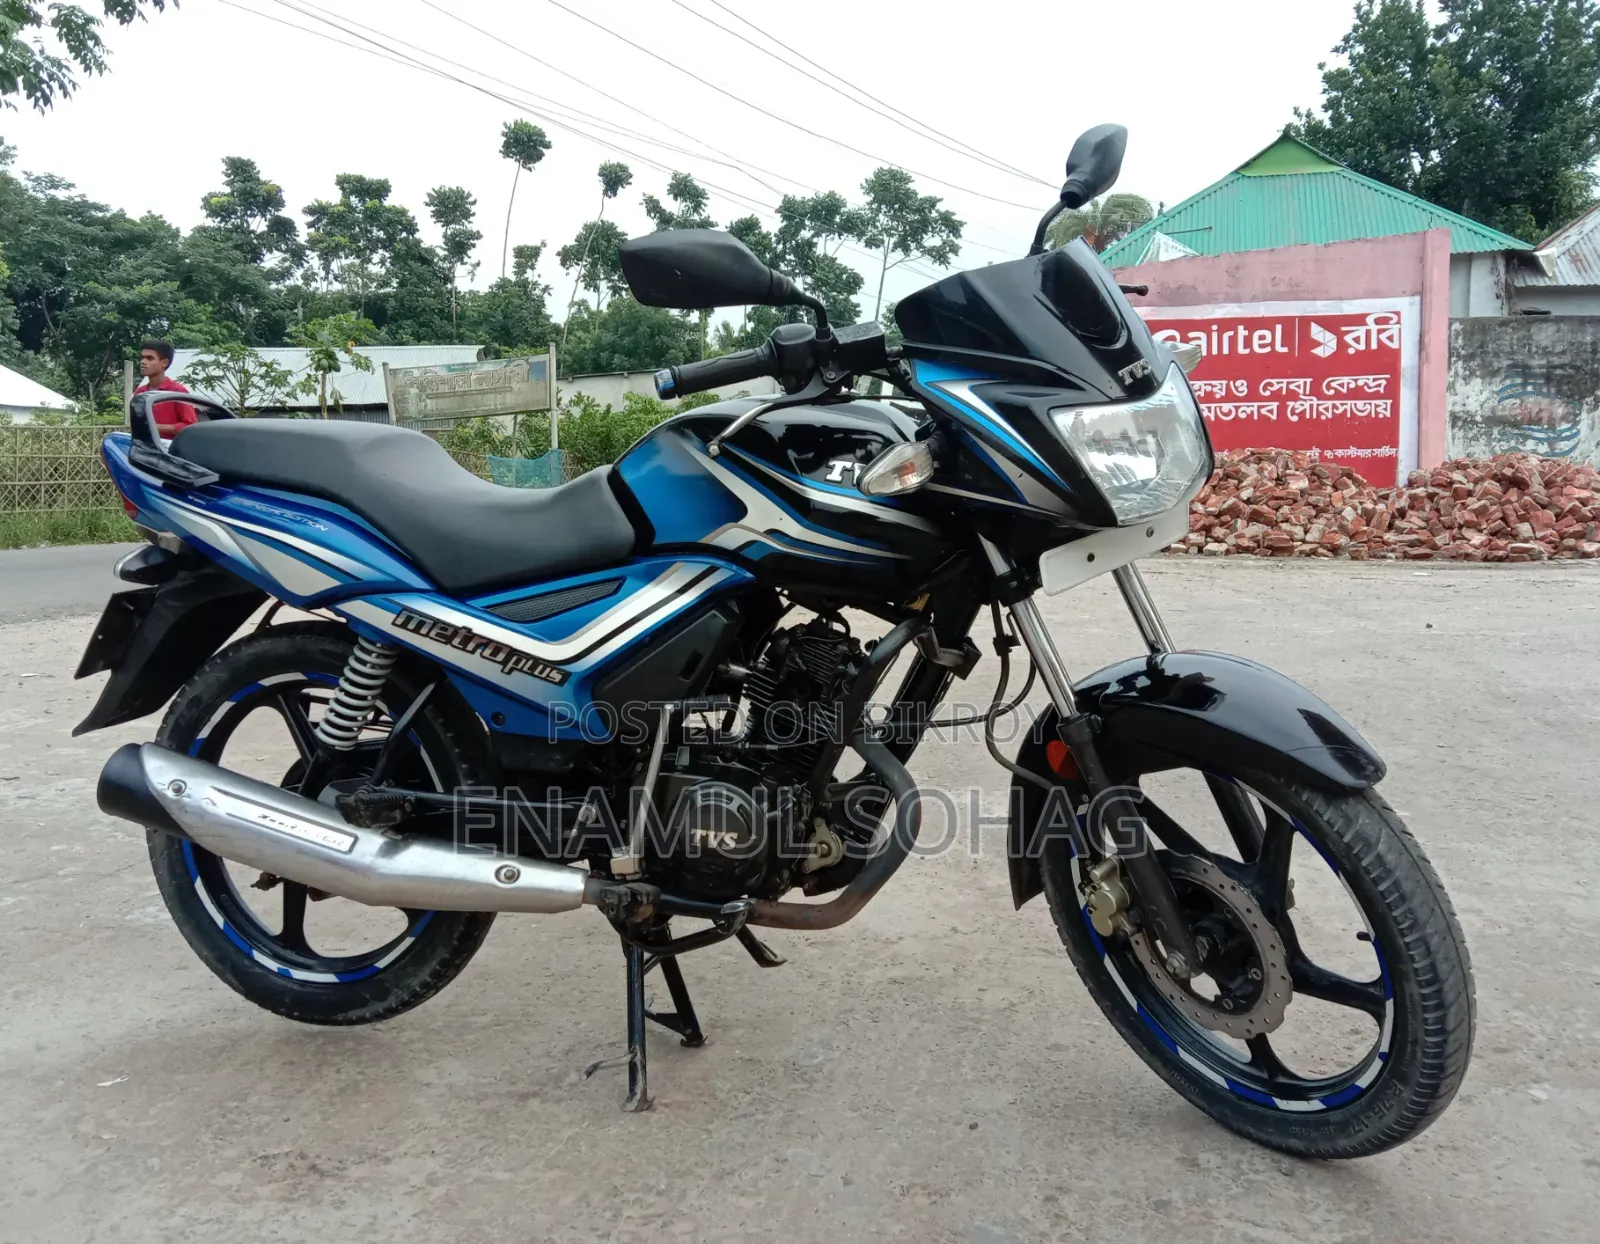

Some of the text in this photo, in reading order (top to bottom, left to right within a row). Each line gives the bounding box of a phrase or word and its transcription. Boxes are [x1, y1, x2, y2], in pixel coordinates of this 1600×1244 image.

[1187, 324, 1288, 357] airtel
[1342, 312, 1401, 355] রবি
[1118, 358, 1152, 386] TVS
[1259, 378, 1313, 397] সেবা
[1322, 375, 1390, 395] কেন্দ্র
[1200, 395, 1393, 422] মতলব পৌরসভায়
[393, 608, 511, 663] metro
[690, 828, 738, 850] TVS
